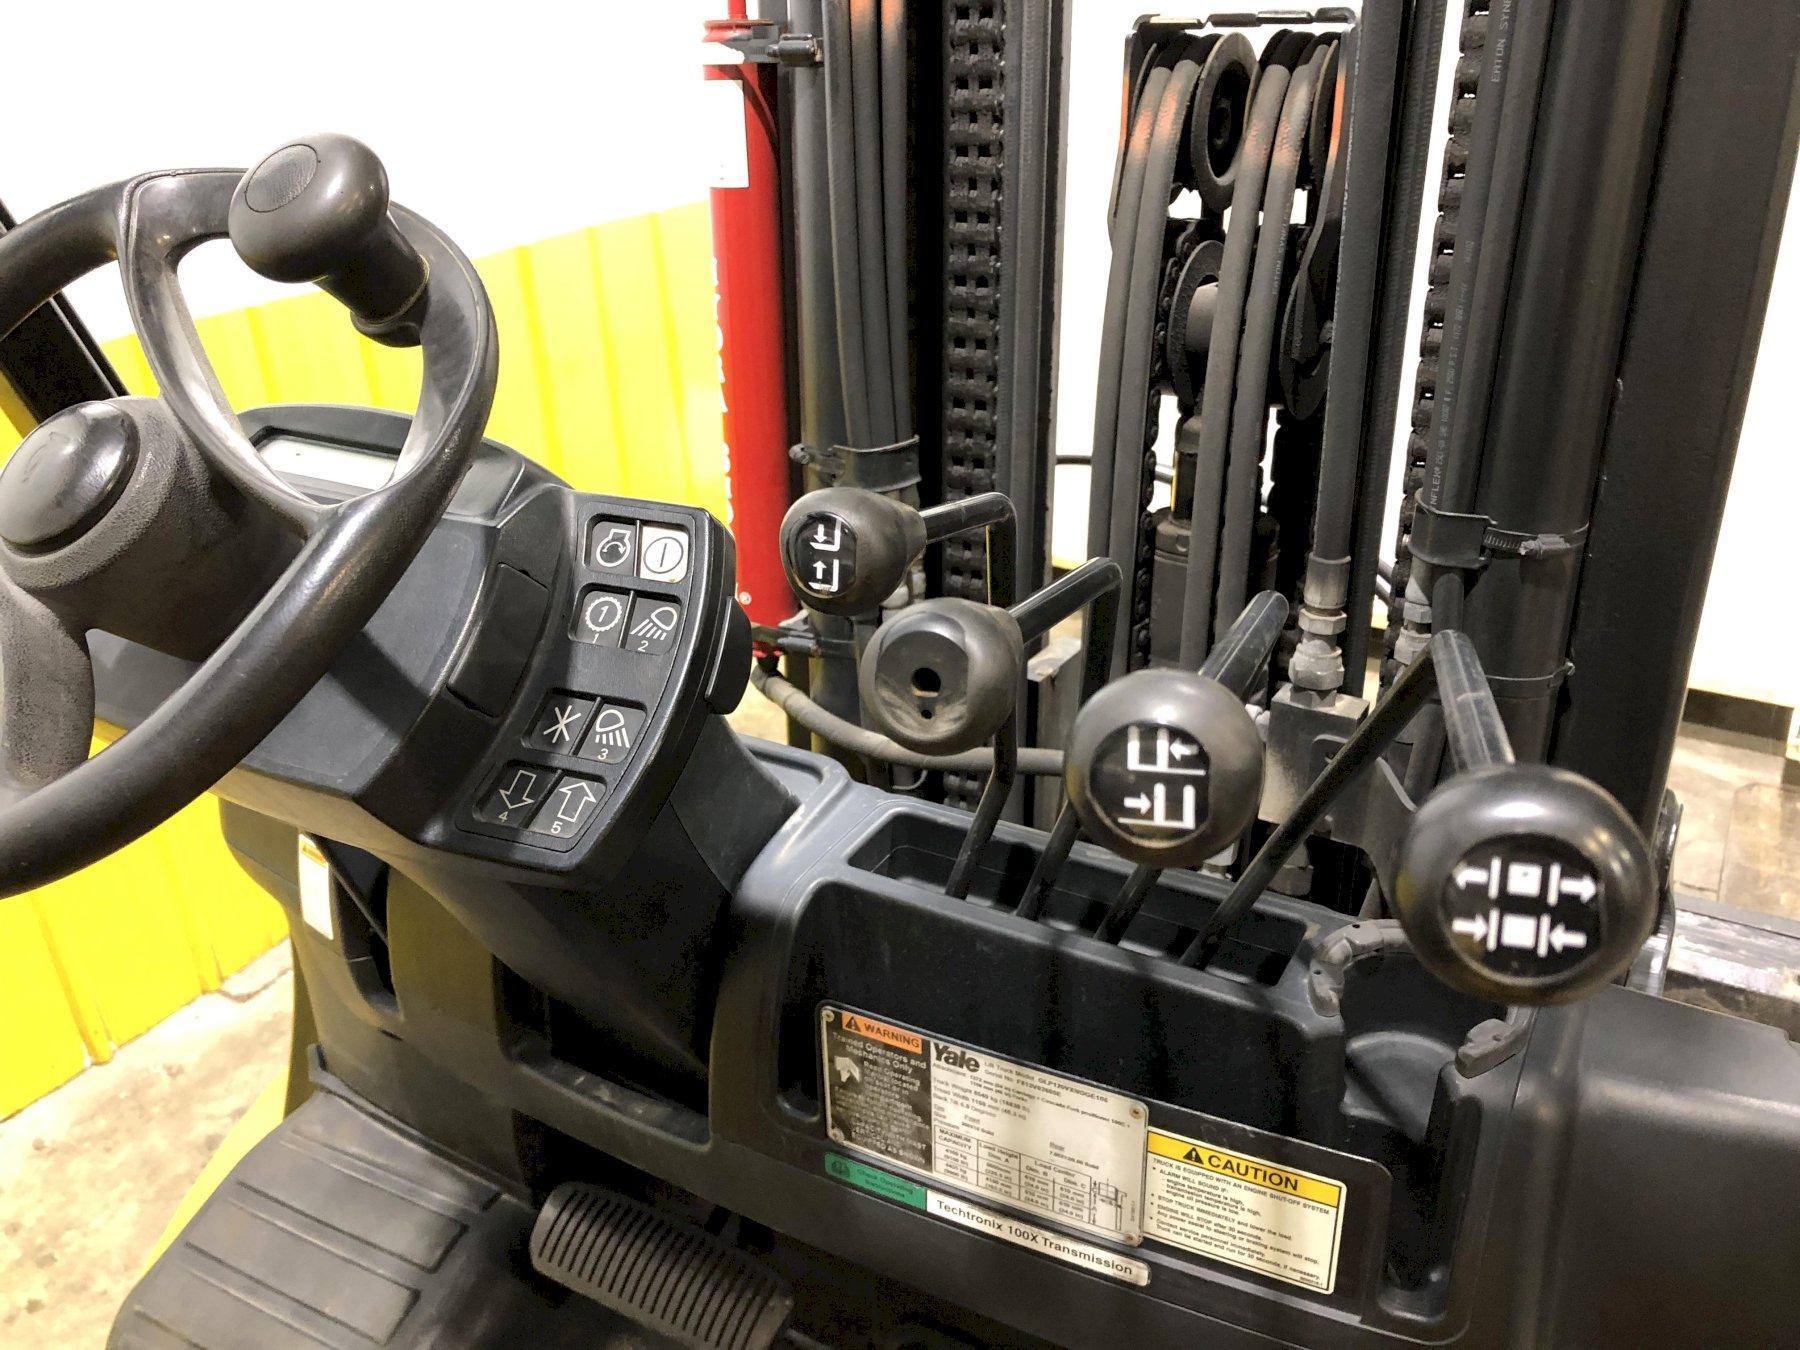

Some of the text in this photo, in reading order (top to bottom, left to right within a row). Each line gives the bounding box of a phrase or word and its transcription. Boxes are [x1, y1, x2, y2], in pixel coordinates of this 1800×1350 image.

[637, 640, 650, 653] 2
[597, 748, 609, 760] 3
[498, 812, 509, 823] 4
[551, 821, 562, 834] 5
[864, 1023, 920, 1048] WARNING
[865, 1041, 907, 1064] Operators
[910, 1056, 926, 1070] and
[892, 1059, 912, 1075] Only
[934, 1042, 980, 1073] Yale
[997, 1064, 1013, 1074] Truck
[1014, 1070, 1034, 1081] Model
[938, 1134, 971, 1150] CAPACITY
[939, 1127, 970, 1143] MAXIMUM
[1034, 1159, 1052, 1171] Load
[1207, 1155, 1299, 1192] CAUTION
[1152, 1157, 1329, 1215] TRUCK IS EQUIPPED WITH AN ENGINE SHUT-OFF SYSTEM
[1159, 1168, 1180, 1179] ALARM
[1181, 1175, 1195, 1184] WILL
[1197, 1179, 1219, 1191] SOUND
[1166, 1178, 1185, 1188] engine
[1186, 1184, 1221, 1199] temperature
[1165, 1189, 1184, 1199] engine
[1194, 1197, 1220, 1210] pressure
[1166, 1183, 1202, 1199] transmission
[1203, 1194, 1238, 1210] temperature
[1157, 1195, 1173, 1204] STOP
[1174, 1200, 1194, 1210] TRUCK
[1196, 1206, 1235, 1223] IMMEDIATELY
[1237, 1219, 1248, 1227] and
[1249, 1223, 1265, 1232] lower
[1267, 1228, 1276, 1236] the
[1157, 1203, 1178, 1214] ENGINE
[1180, 1210, 1194, 1219] WILL
[1196, 1215, 1212, 1225] STOP
[1213, 1220, 1226, 1229] after
[936, 1200, 1133, 1276] Techtronix 100X Transmission
[1156, 1218, 1177, 1229] Contact
[1179, 1226, 1199, 1236] service
[1200, 1233, 1228, 1245] personnel
[1156, 1223, 1170, 1232] Truck
[1192, 1235, 1212, 1245] started
[1213, 1242, 1224, 1250] and
[1157, 1210, 1167, 1218] Any
[1169, 1213, 1186, 1223] power
[1213, 1227, 1236, 1239] steering
[1245, 1238, 1267, 1249] braking
[1269, 1245, 1290, 1256] system
[1292, 1252, 1302, 1260] will
